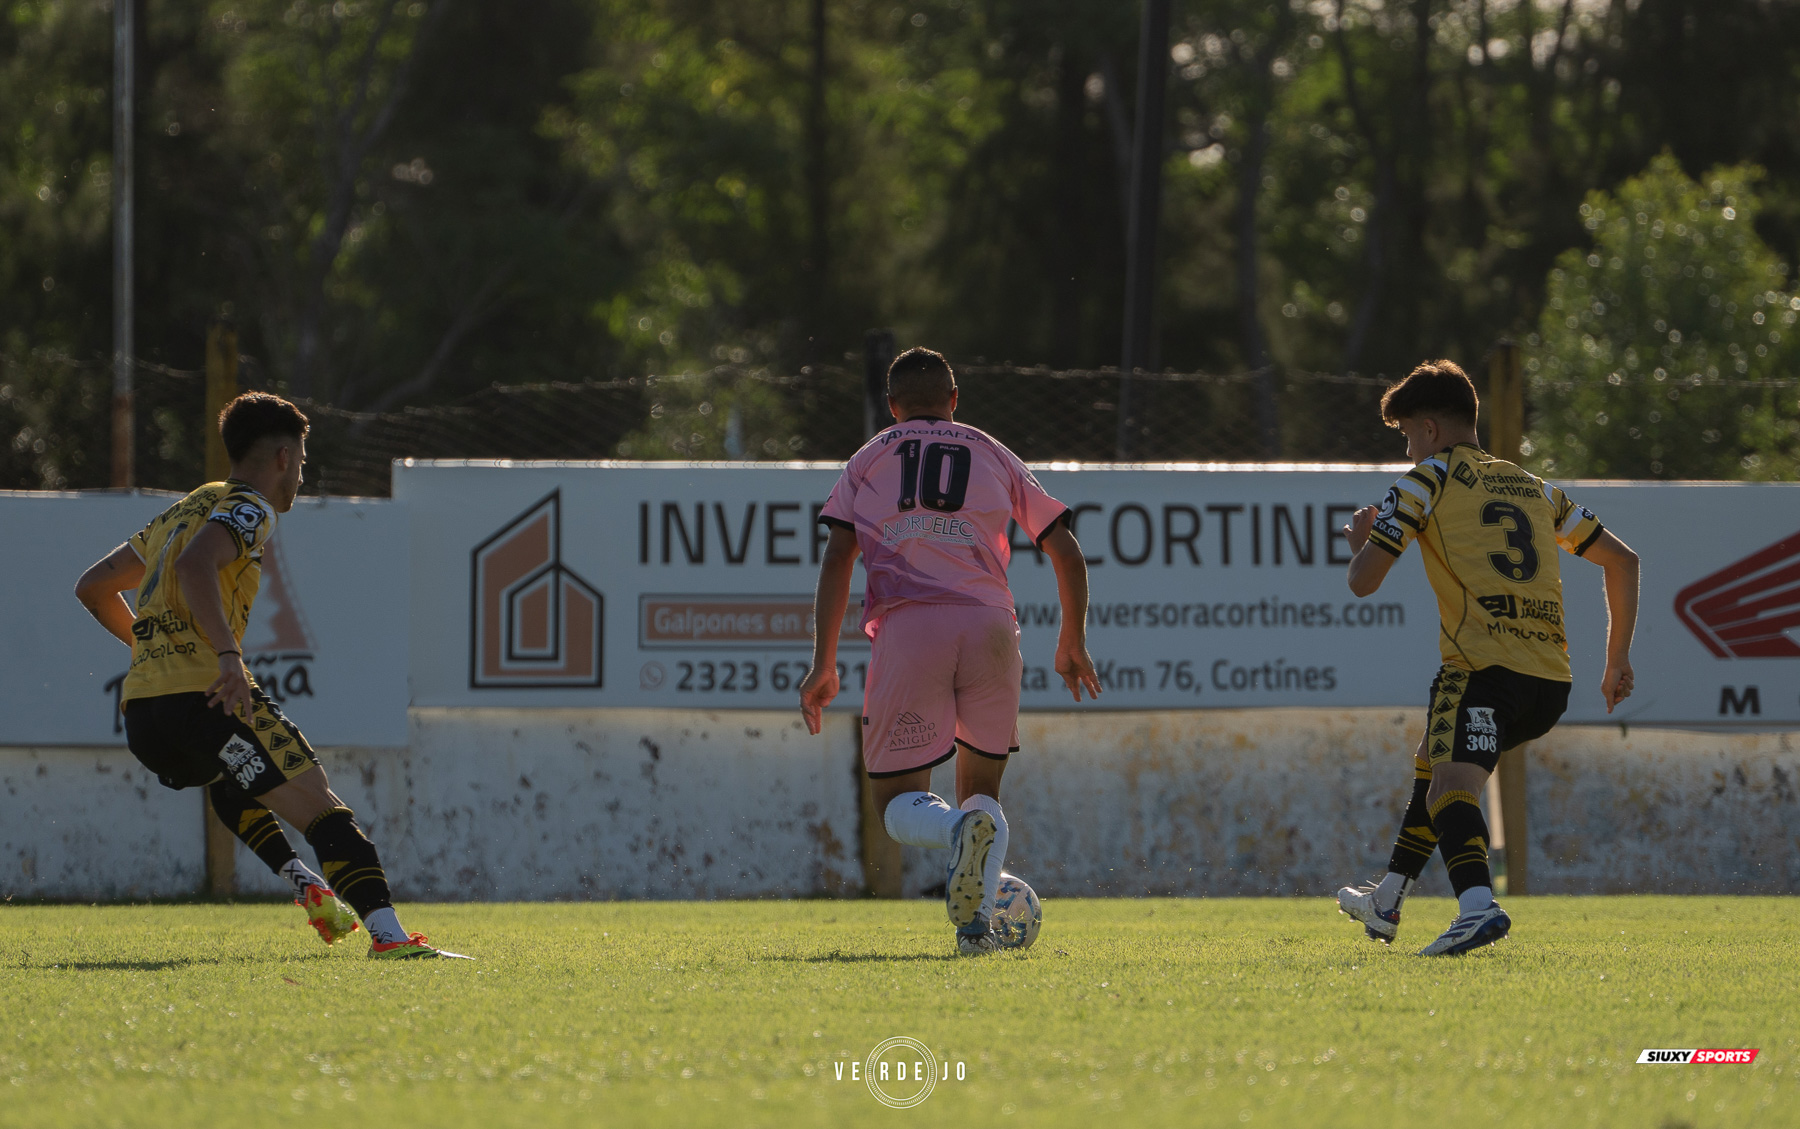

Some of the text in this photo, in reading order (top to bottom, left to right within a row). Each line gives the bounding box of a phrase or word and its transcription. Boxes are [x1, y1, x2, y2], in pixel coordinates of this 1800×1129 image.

[894, 439, 971, 513] 10
[1483, 482, 1542, 499] Cortines
[883, 515, 975, 540] NORDELEC
[1068, 502, 1383, 566] CORTINE
[1480, 500, 1540, 583] 3
[654, 606, 766, 639] Galpones
[770, 612, 800, 634] en
[677, 661, 759, 693] 2323
[1097, 659, 1146, 691] Km
[1156, 660, 1202, 695] 76,
[1211, 658, 1337, 692] Cortínes
[1466, 734, 1497, 753] 308
[236, 756, 266, 790] 308
